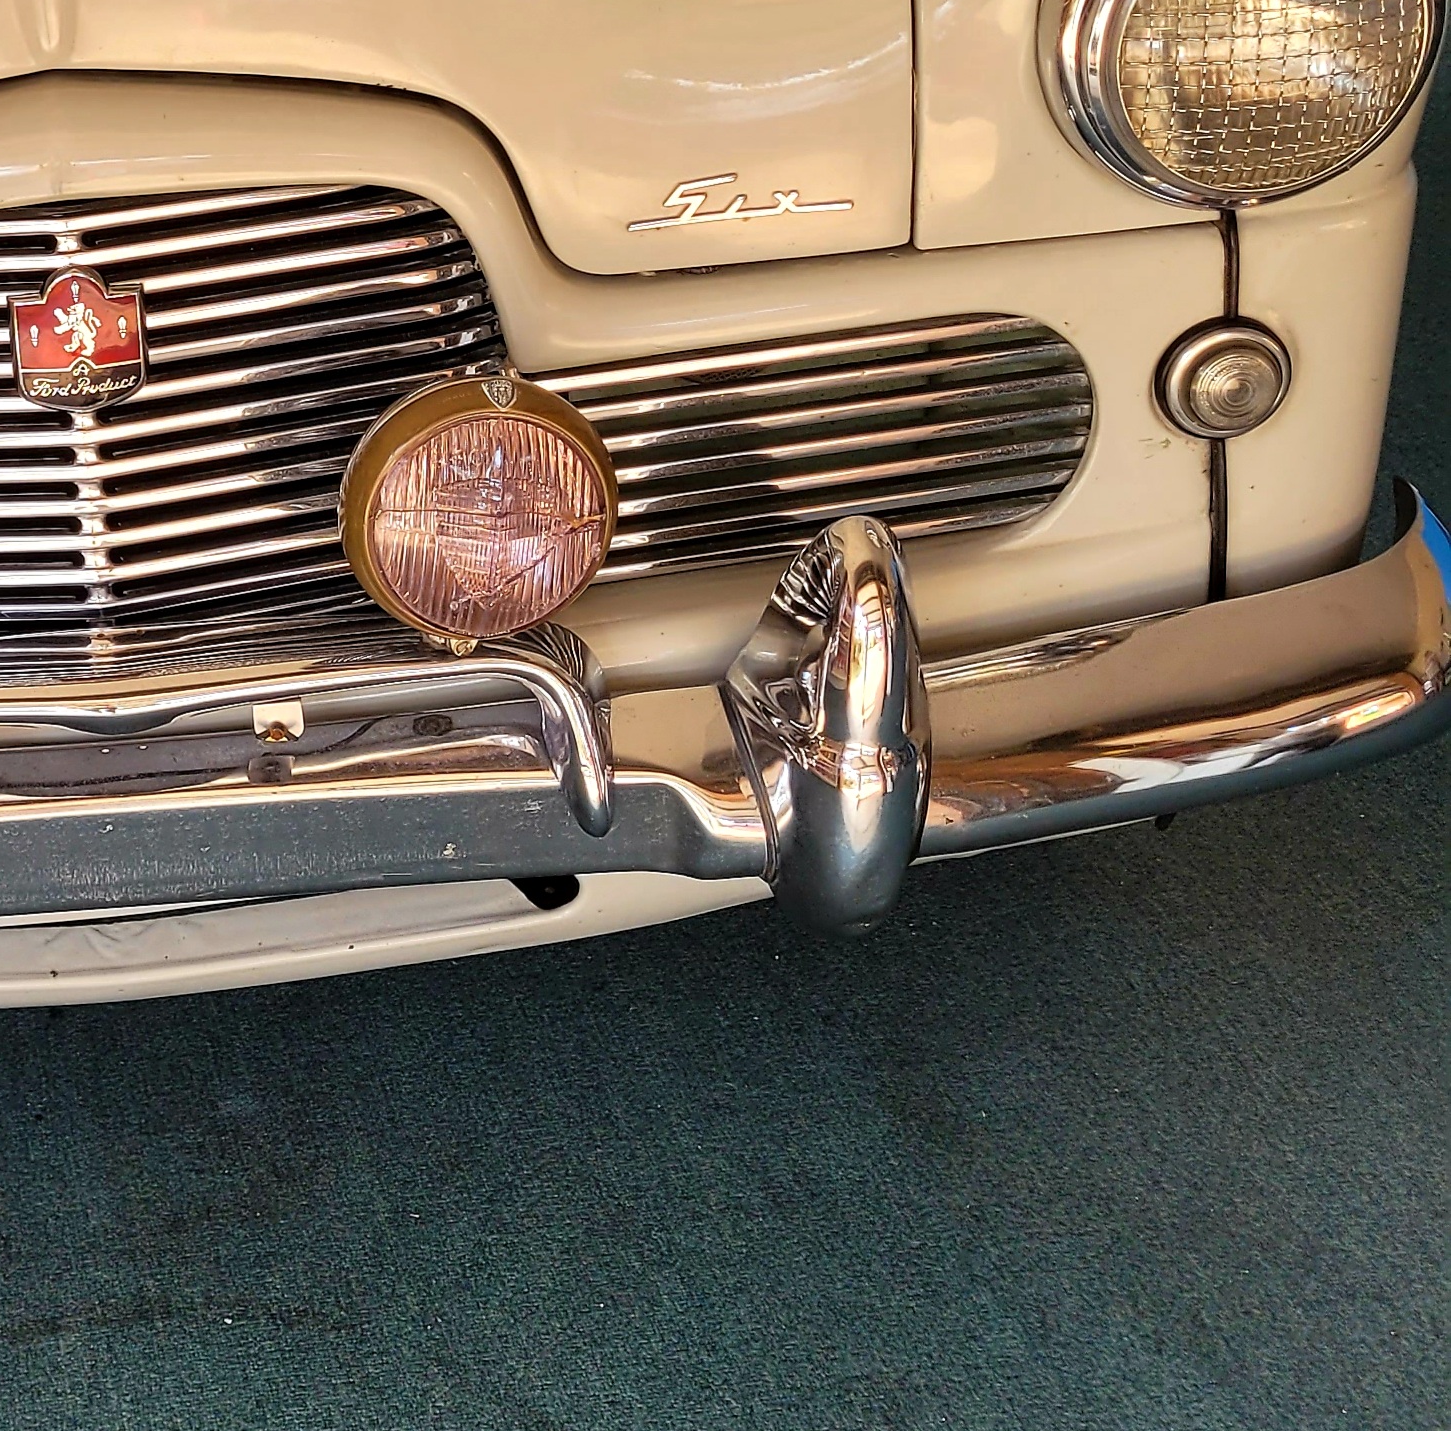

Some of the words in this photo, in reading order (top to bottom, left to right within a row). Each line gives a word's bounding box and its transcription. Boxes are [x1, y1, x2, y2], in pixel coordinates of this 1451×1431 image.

[626, 172, 854, 232] Six
[73, 364, 90, 376] A
[29, 377, 72, 397] Ford
[71, 374, 138, 395] Product
